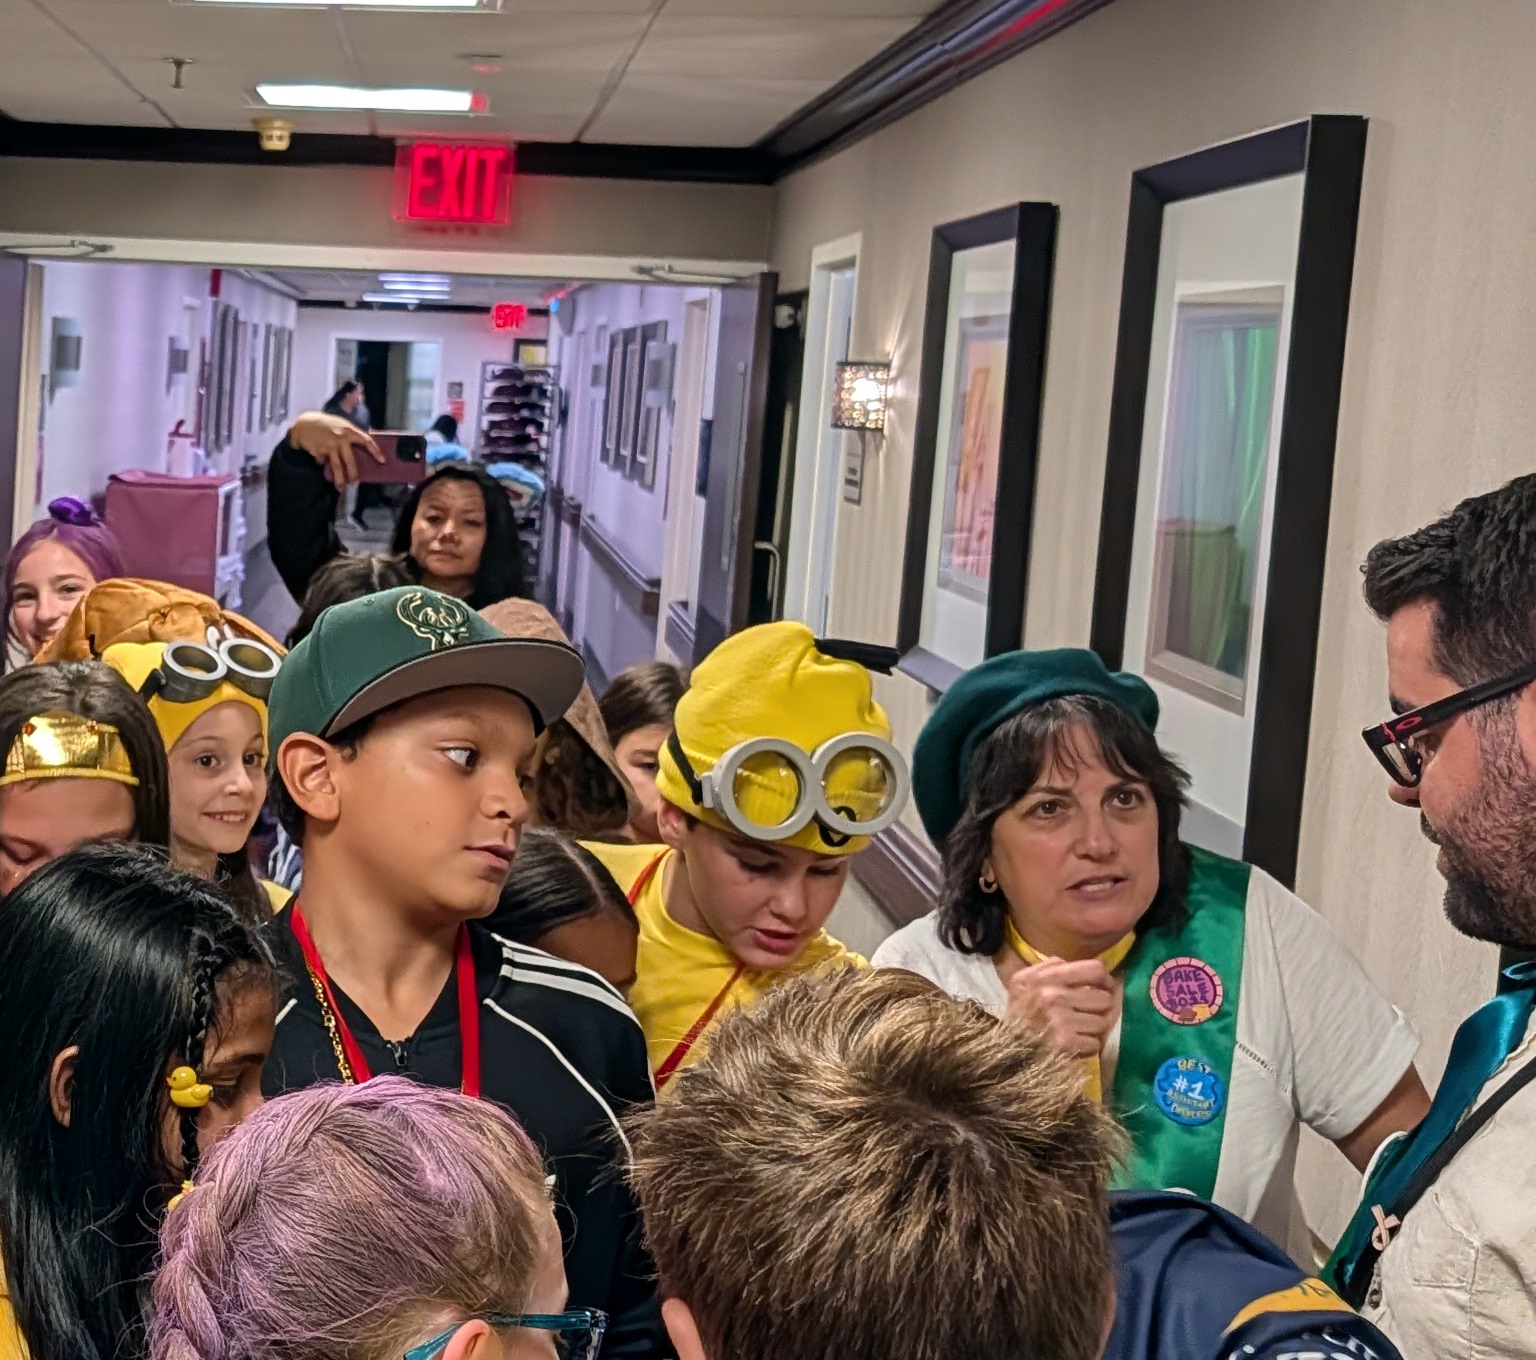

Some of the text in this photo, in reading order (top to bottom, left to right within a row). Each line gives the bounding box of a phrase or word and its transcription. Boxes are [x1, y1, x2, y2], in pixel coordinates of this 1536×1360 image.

[408, 143, 508, 221] EXIT
[1166, 982, 1210, 998] SALE
[1172, 1074, 1206, 1101] #1
